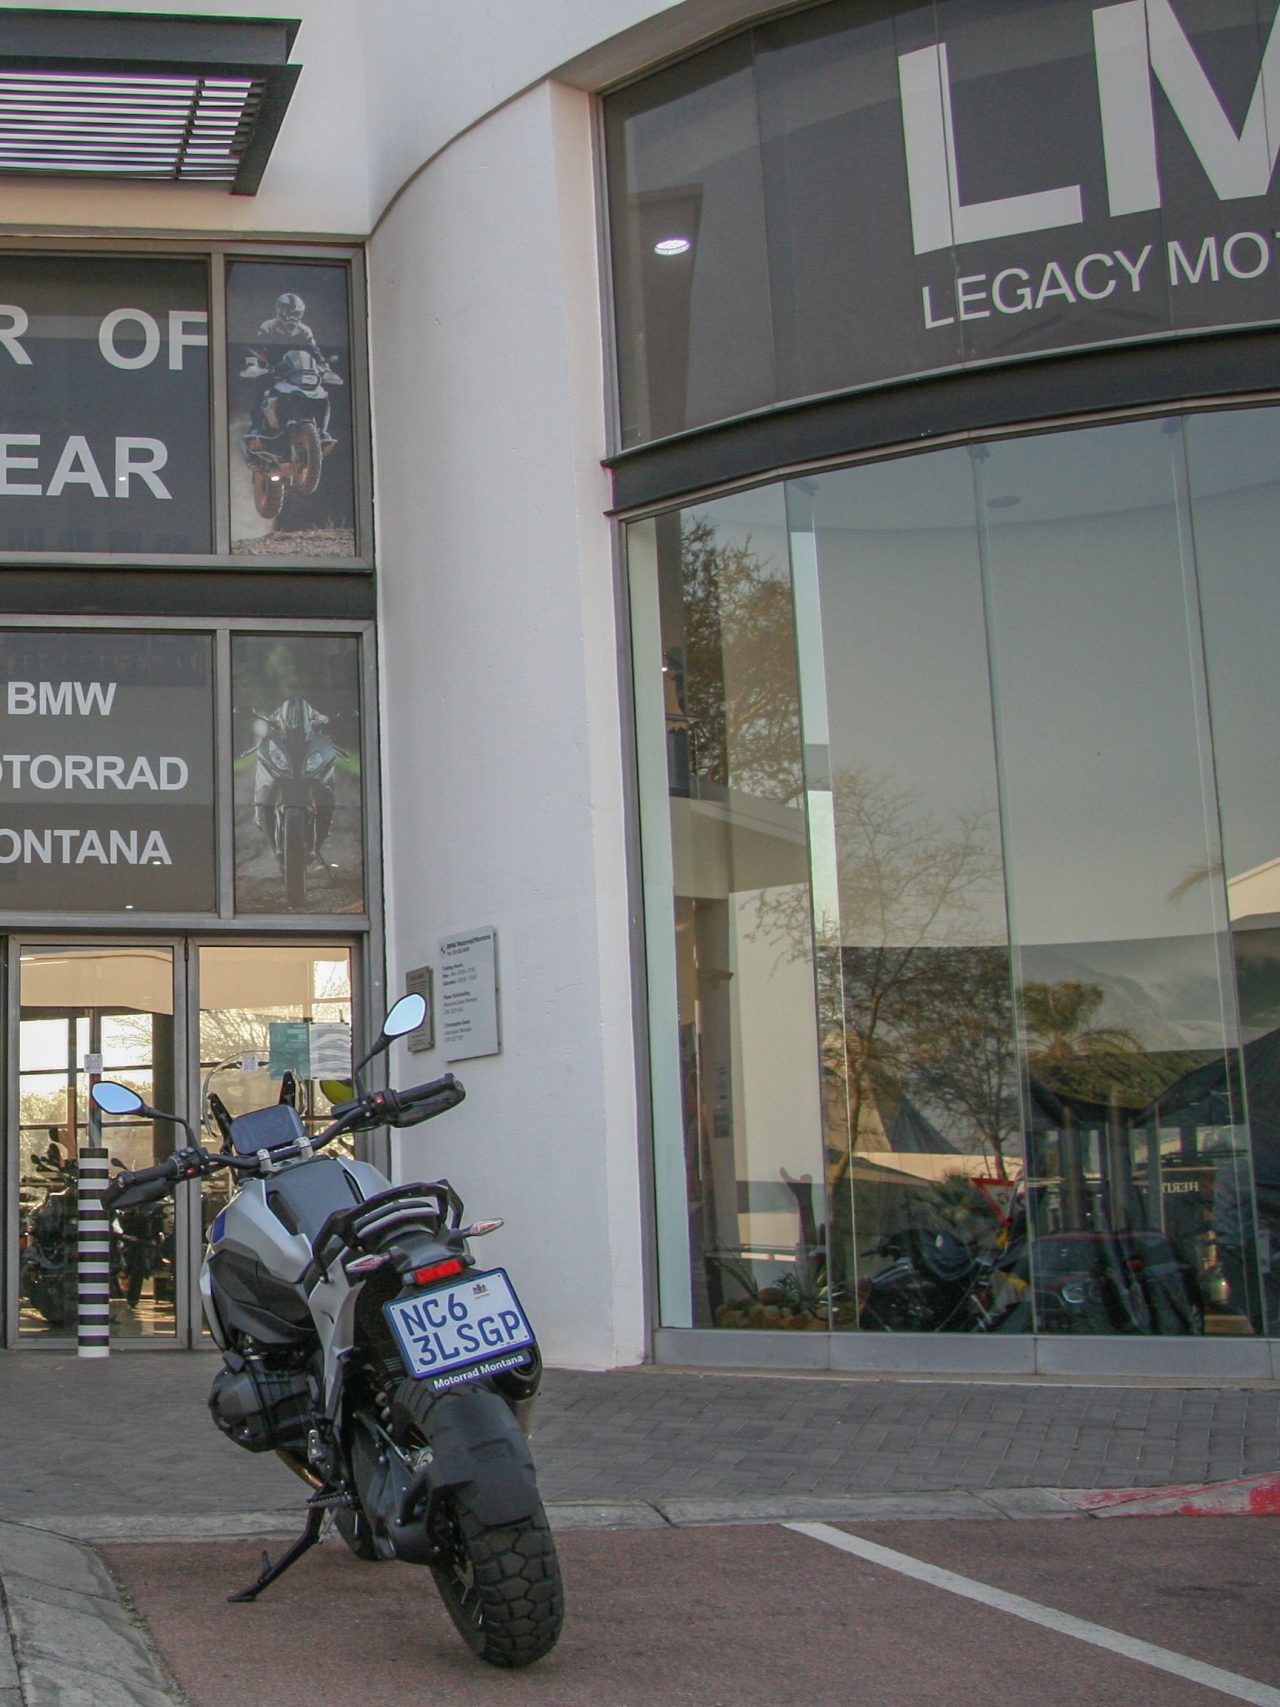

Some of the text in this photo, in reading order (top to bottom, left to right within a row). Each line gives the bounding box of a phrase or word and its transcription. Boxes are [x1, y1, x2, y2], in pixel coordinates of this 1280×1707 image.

[922, 231, 1280, 329] LEGACY MO
[98, 308, 208, 371] OF
[7, 681, 117, 717] BMW
[399, 1293, 468, 1336] NC6
[412, 1310, 520, 1366] 3LSGP
[433, 1354, 524, 1389] Motorrad Montana
